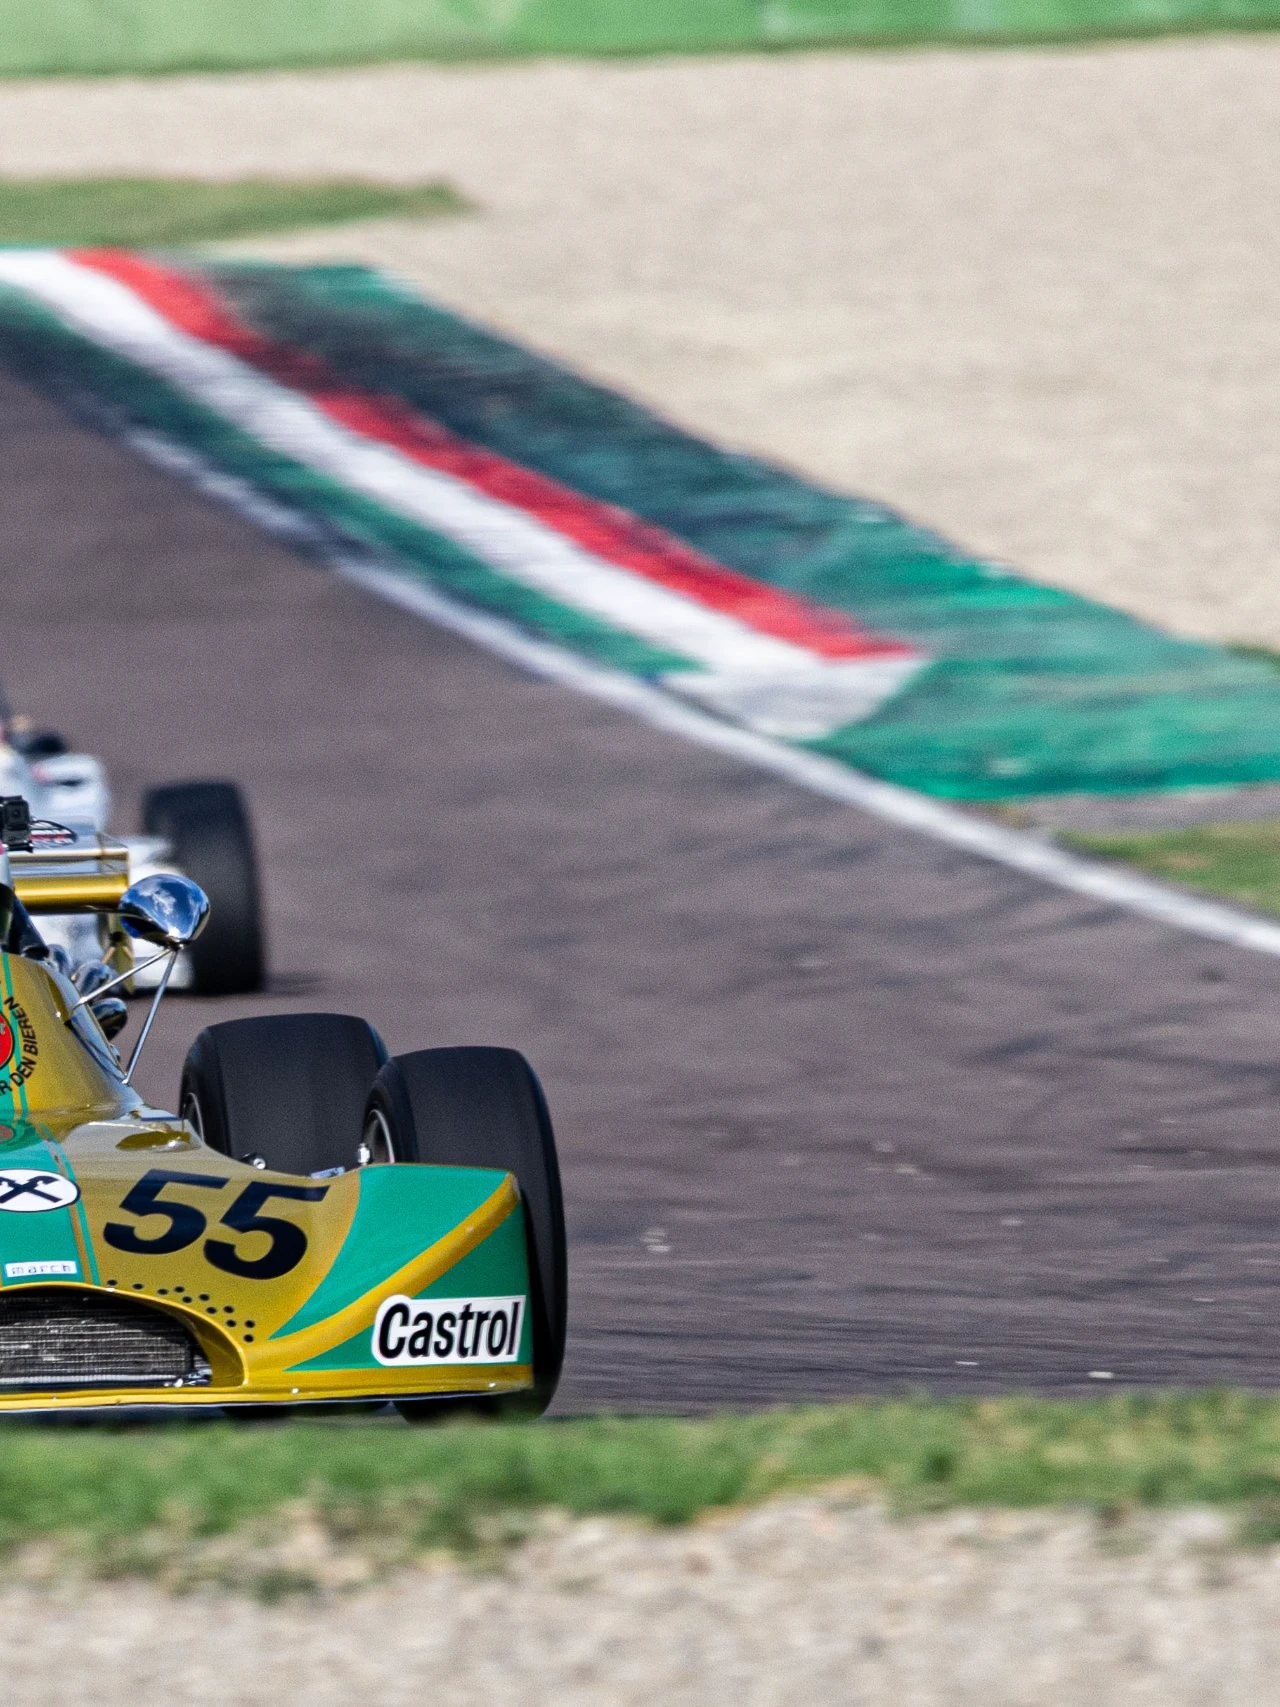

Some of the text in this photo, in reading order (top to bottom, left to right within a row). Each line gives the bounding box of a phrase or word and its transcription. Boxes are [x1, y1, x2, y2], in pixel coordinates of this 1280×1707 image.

[3, 996, 39, 1057] BIEREN
[9, 1056, 37, 1087] DEN
[102, 1168, 331, 1280] 55
[379, 1302, 521, 1360] Castrol
